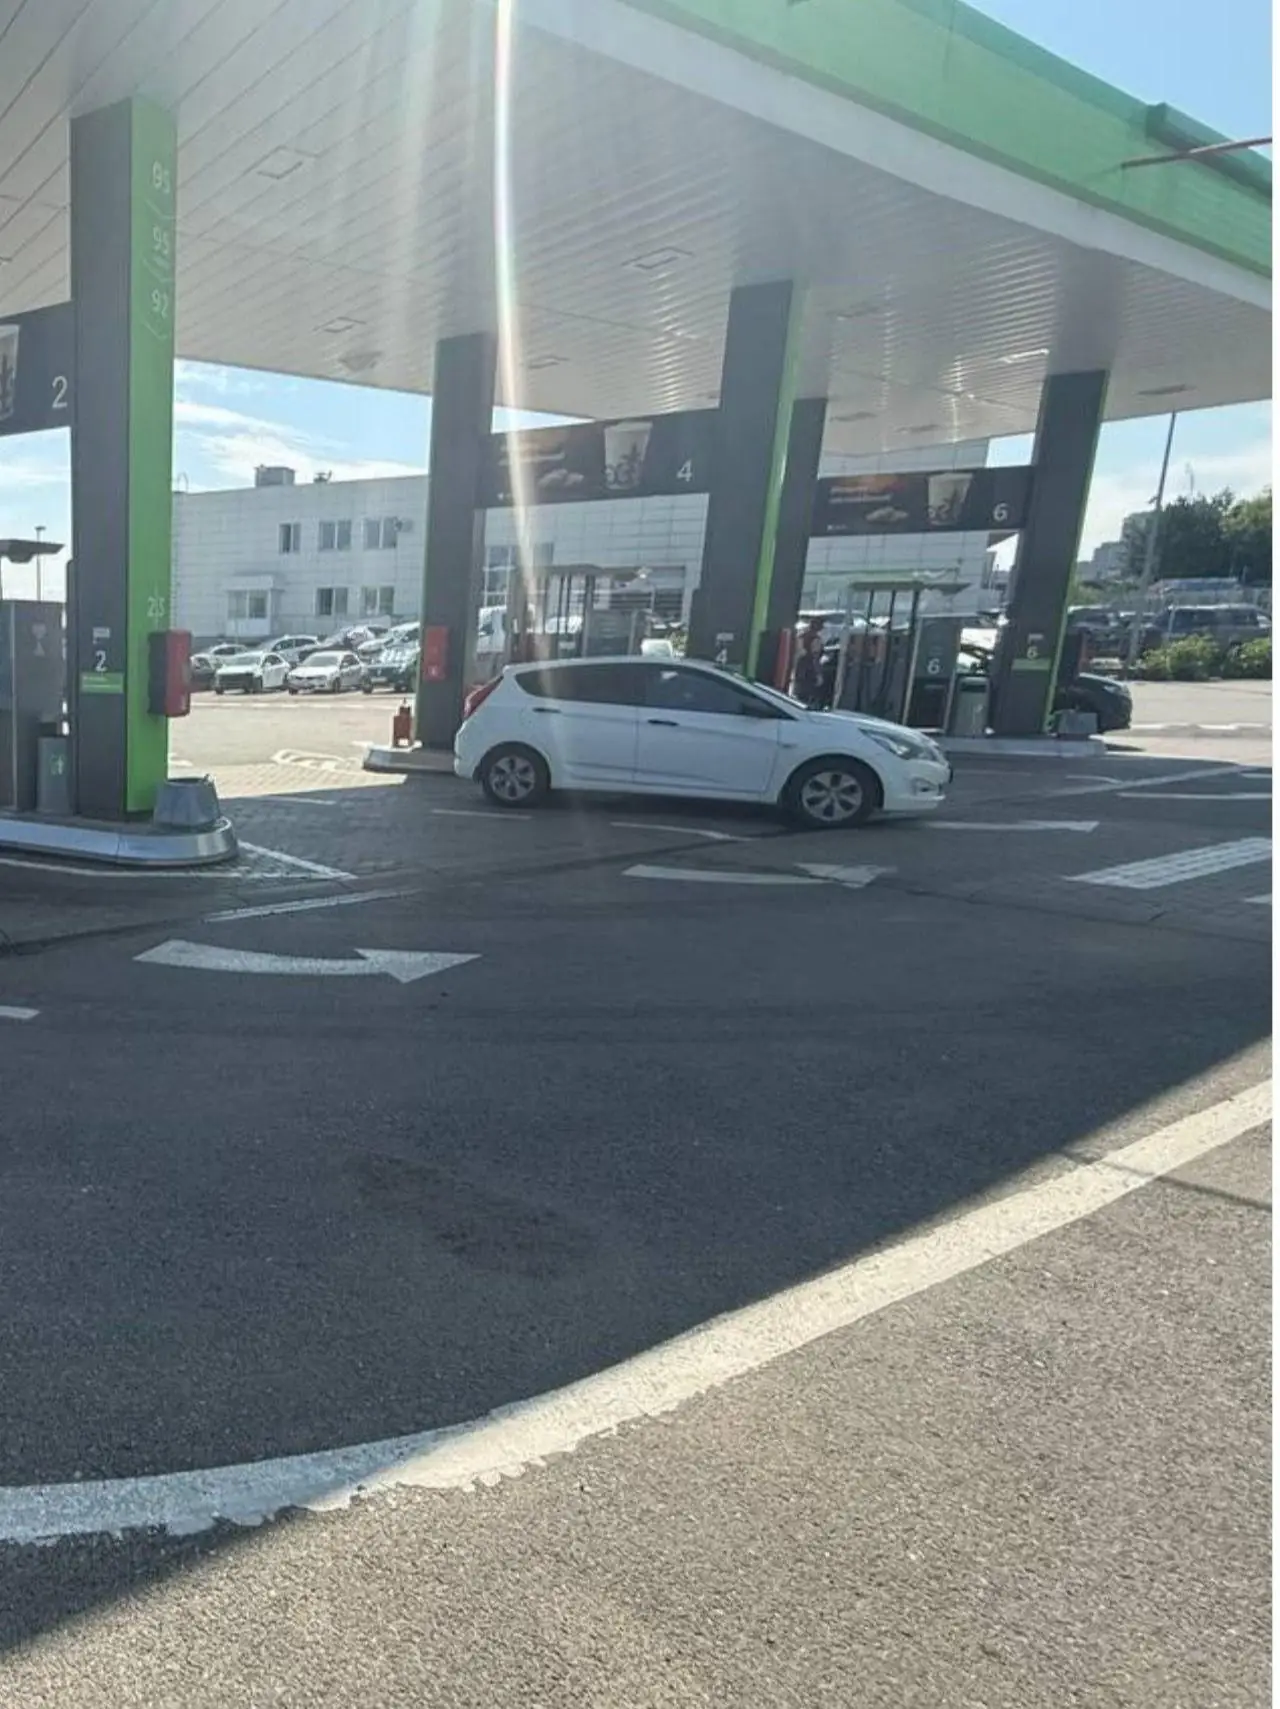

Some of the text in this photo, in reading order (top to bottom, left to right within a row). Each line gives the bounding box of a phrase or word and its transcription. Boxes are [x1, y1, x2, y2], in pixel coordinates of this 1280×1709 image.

[51, 375, 68, 409] 2
[676, 459, 693, 483] 4
[992, 502, 1009, 522] 6
[95, 650, 108, 672] 2
[927, 658, 941, 675] 6
